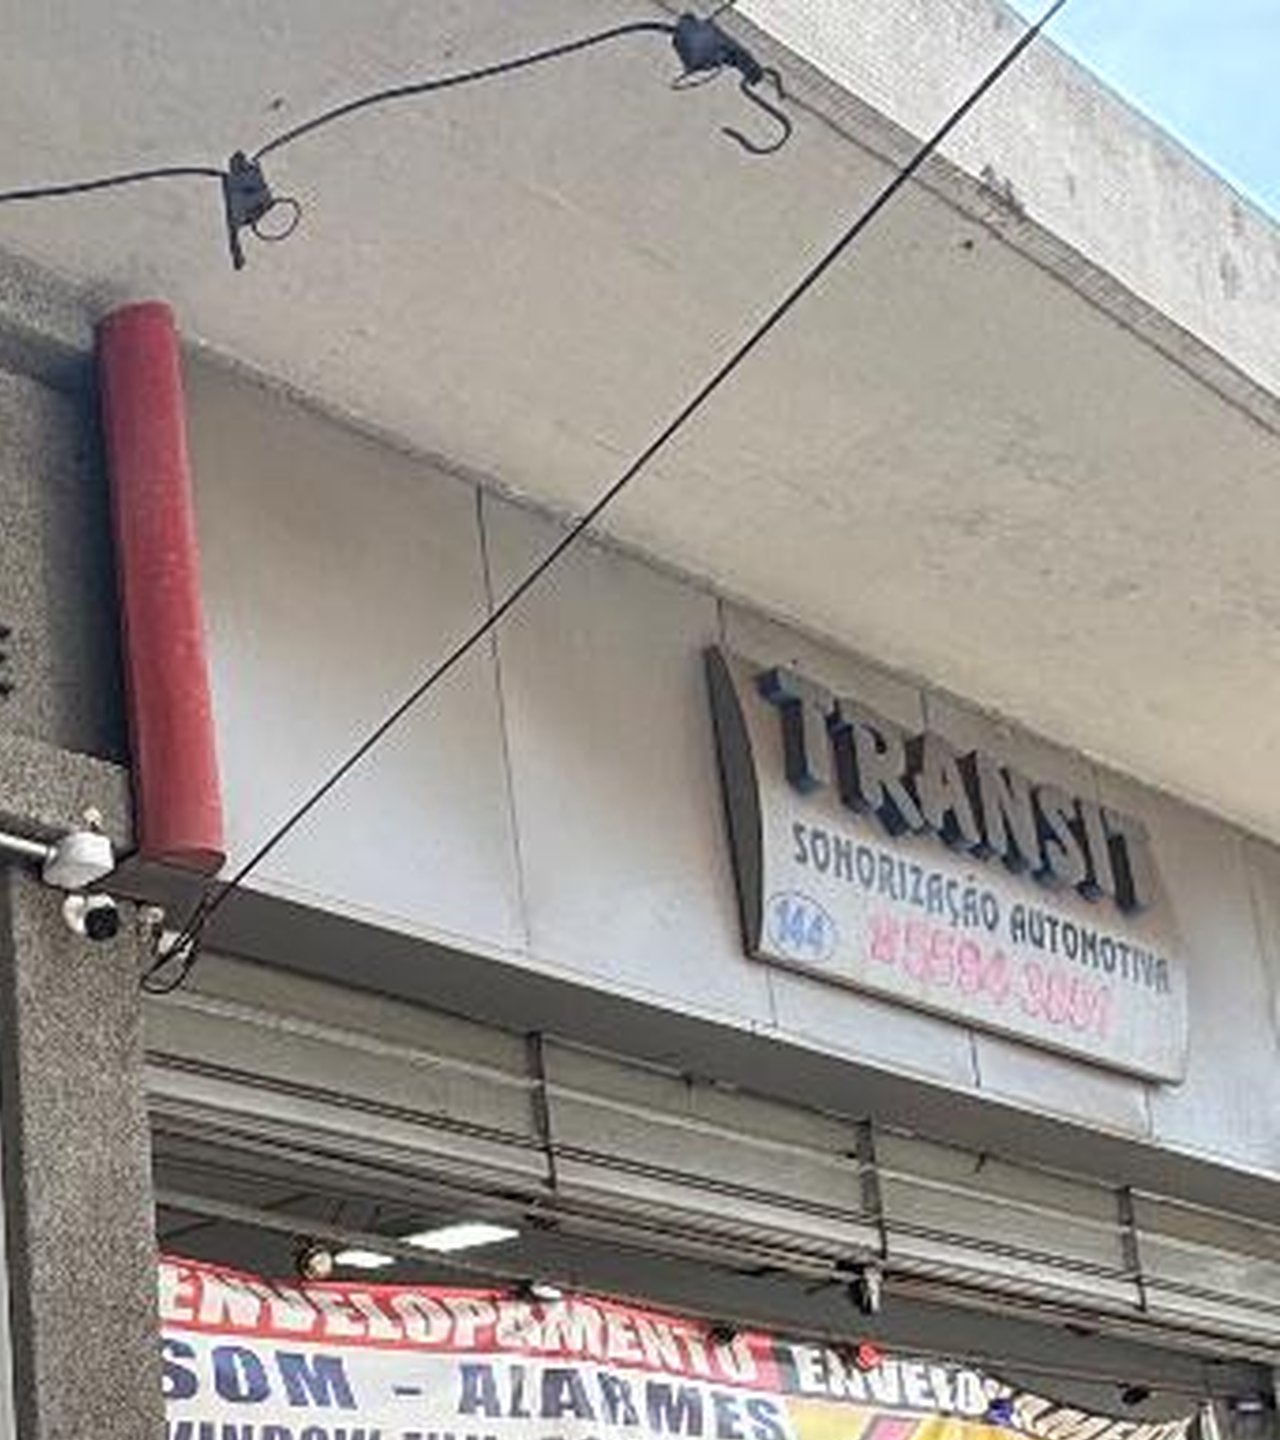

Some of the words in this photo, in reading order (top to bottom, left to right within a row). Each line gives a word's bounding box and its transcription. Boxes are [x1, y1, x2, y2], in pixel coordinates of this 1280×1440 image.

[756, 664, 1150, 916] TRANSIT
[1009, 903, 1170, 994] AUTOMOTIVA
[162, 1337, 358, 1411] SOM
